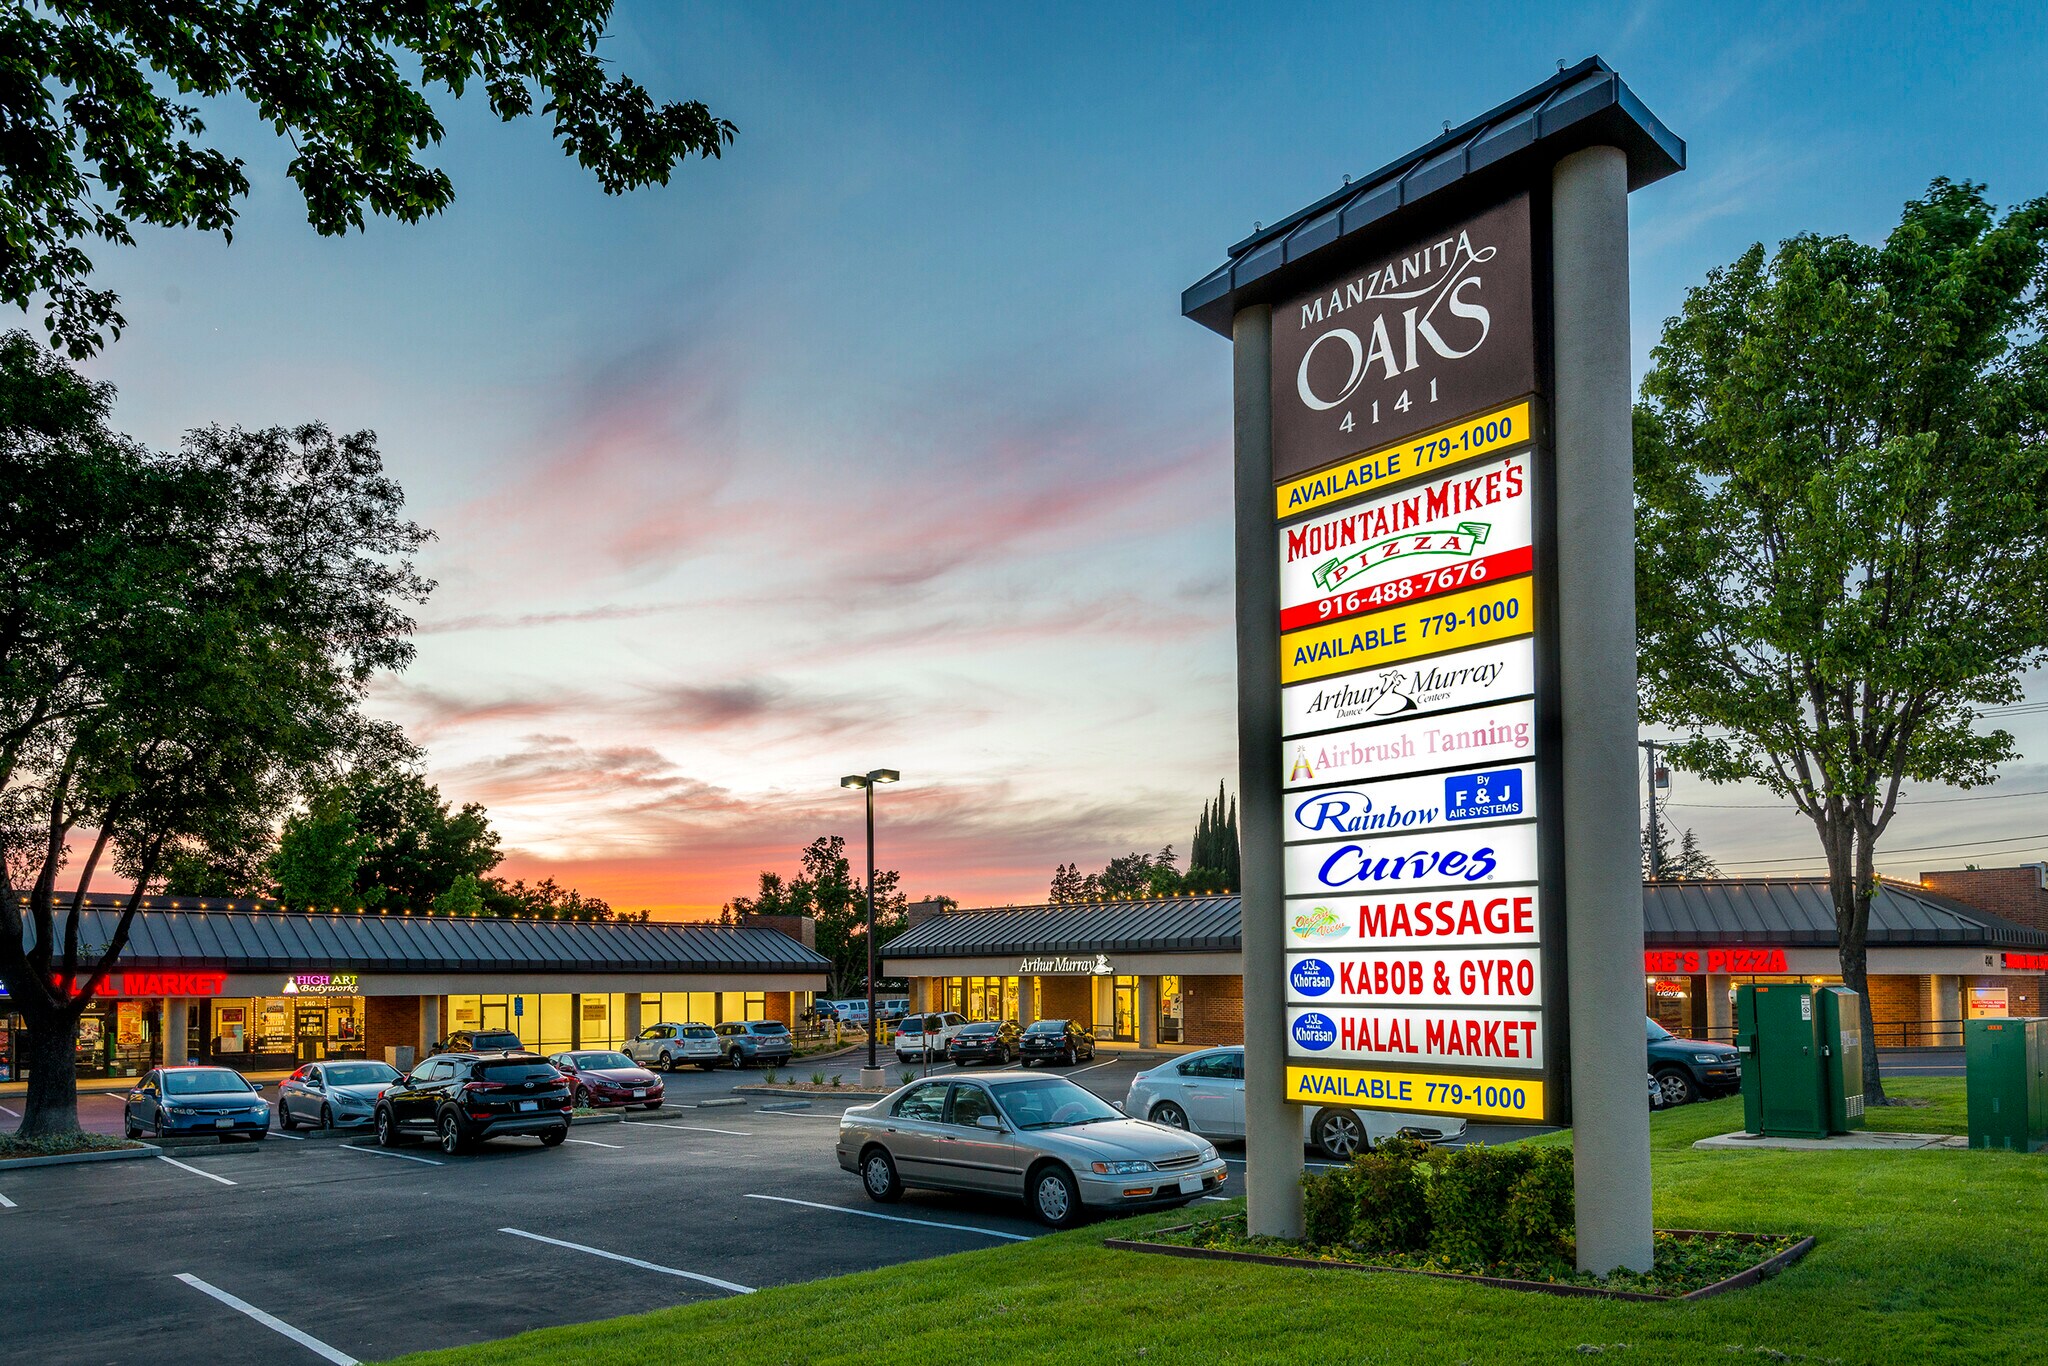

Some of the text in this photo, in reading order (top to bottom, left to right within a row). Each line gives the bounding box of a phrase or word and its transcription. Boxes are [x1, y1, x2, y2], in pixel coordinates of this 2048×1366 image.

[1300, 229, 1497, 331] MANZANITA
[1297, 276, 1491, 411] OAKS
[1339, 377, 1439, 434] 4141
[1289, 417, 1512, 508] AVAILABLE 779-1000
[1287, 458, 1523, 563] MOUNTAIN MIKE'S
[1334, 536, 1462, 582] PIZZA
[1318, 559, 1487, 619] 916-488-7676
[1293, 598, 1519, 667] AVAILABLE 779-1000
[1306, 661, 1504, 714] Arthur Murray
[1336, 691, 1451, 719] Dance Centers
[1314, 719, 1529, 770] Airbrush Tanning
[1455, 785, 1511, 806] F & J
[1477, 775, 1490, 786] By
[1294, 791, 1439, 832] Rainbow
[1449, 802, 1519, 819] AIR SYSTEMS
[1318, 845, 1497, 887] Curves
[1295, 910, 1345, 936] Ocean View
[1358, 896, 1535, 939] MASSAGE
[296, 975, 358, 985] HIGH ART
[1018, 957, 1096, 974] Arthur Murray
[1293, 959, 1535, 996] Khorasan KABOB & GYRO
[1707, 949, 1788, 973] PIZZA
[123, 973, 227, 996] MARKET
[299, 983, 359, 994] Bodyworks
[1295, 1017, 1537, 1059] Khorasan HALAL MARKET
[1299, 1074, 1526, 1109] AVAILABLE 779-1000
